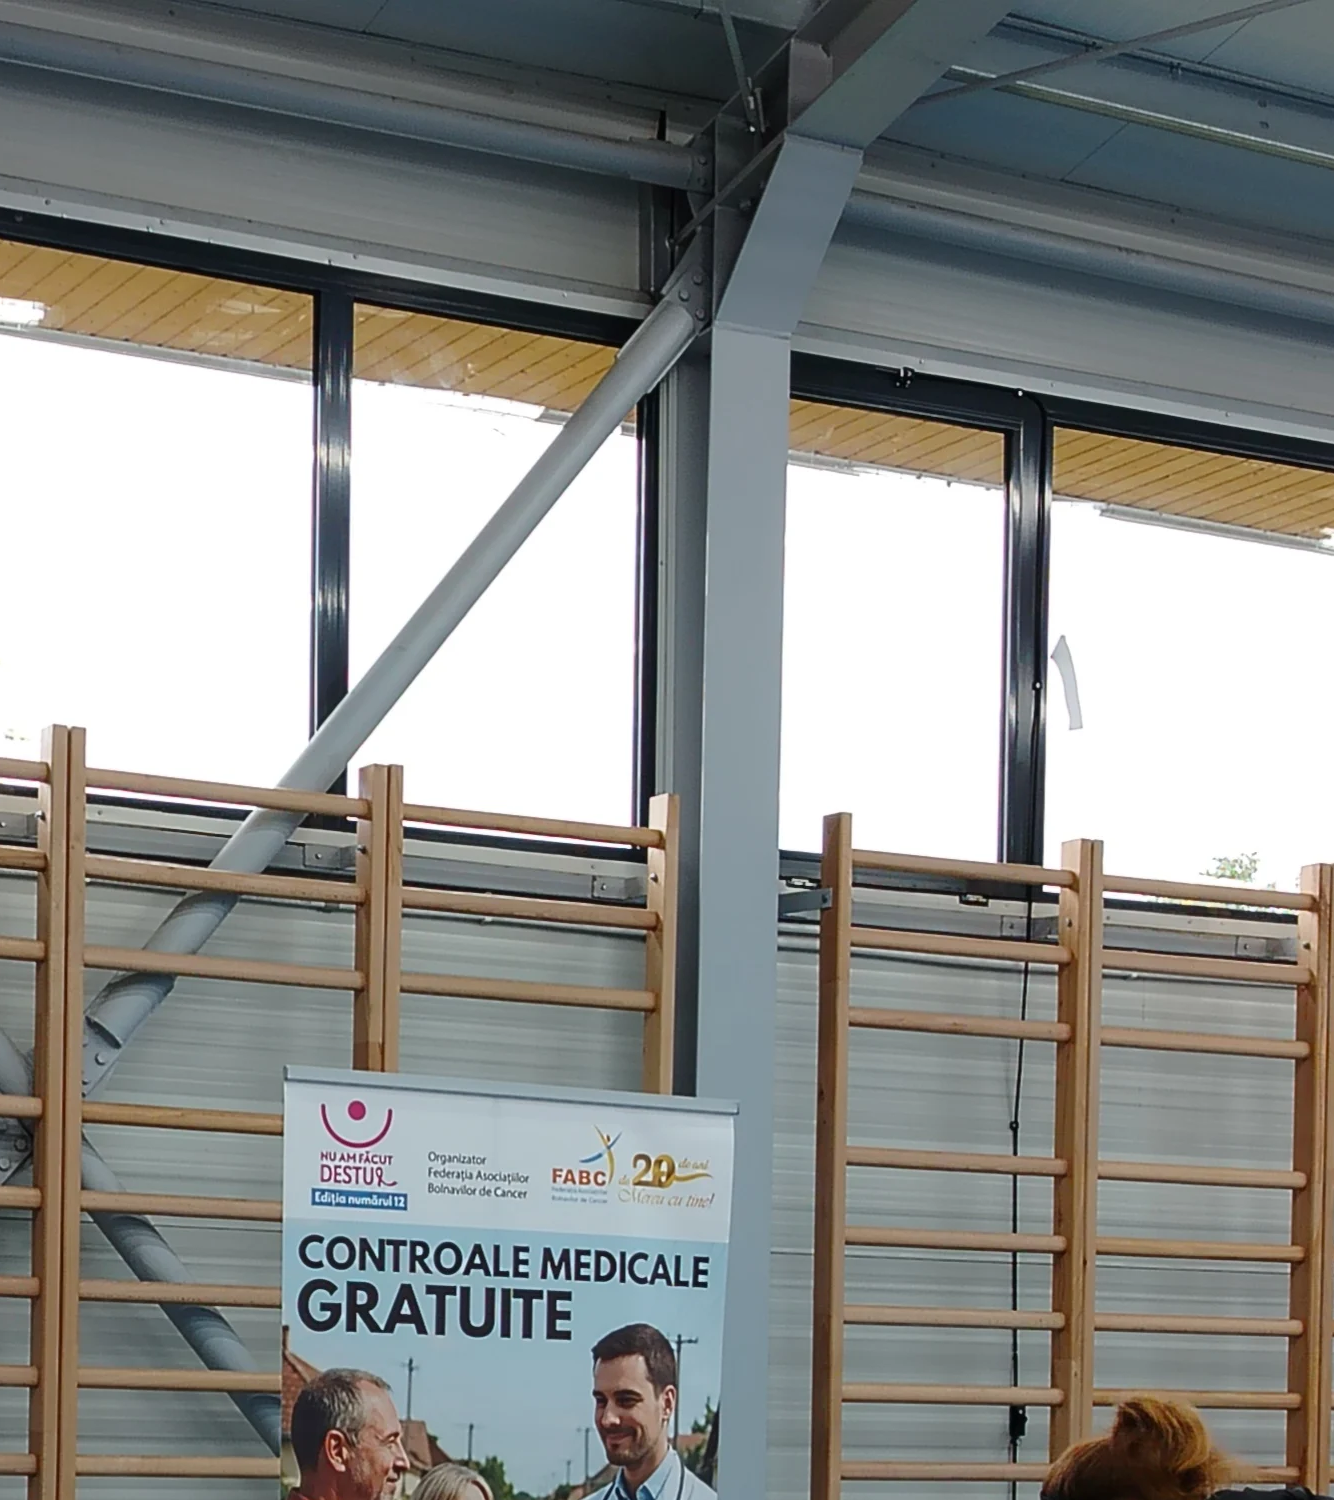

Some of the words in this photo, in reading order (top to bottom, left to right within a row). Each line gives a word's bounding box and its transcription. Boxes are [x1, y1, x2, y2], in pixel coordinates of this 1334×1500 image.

[320, 1151, 337, 1162] NU
[339, 1152, 357, 1163] AM
[358, 1150, 394, 1165] FĂCUT
[427, 1151, 487, 1165] Organizator
[551, 1167, 607, 1187] FABC
[427, 1182, 477, 1196] Bolnavilor
[478, 1186, 492, 1197] de
[493, 1186, 528, 1199] Cancer
[394, 1196, 405, 1208] 12
[298, 1233, 530, 1279] CONTROALE
[540, 1246, 710, 1288] MEDICALE
[297, 1278, 573, 1341] GRATUITE
